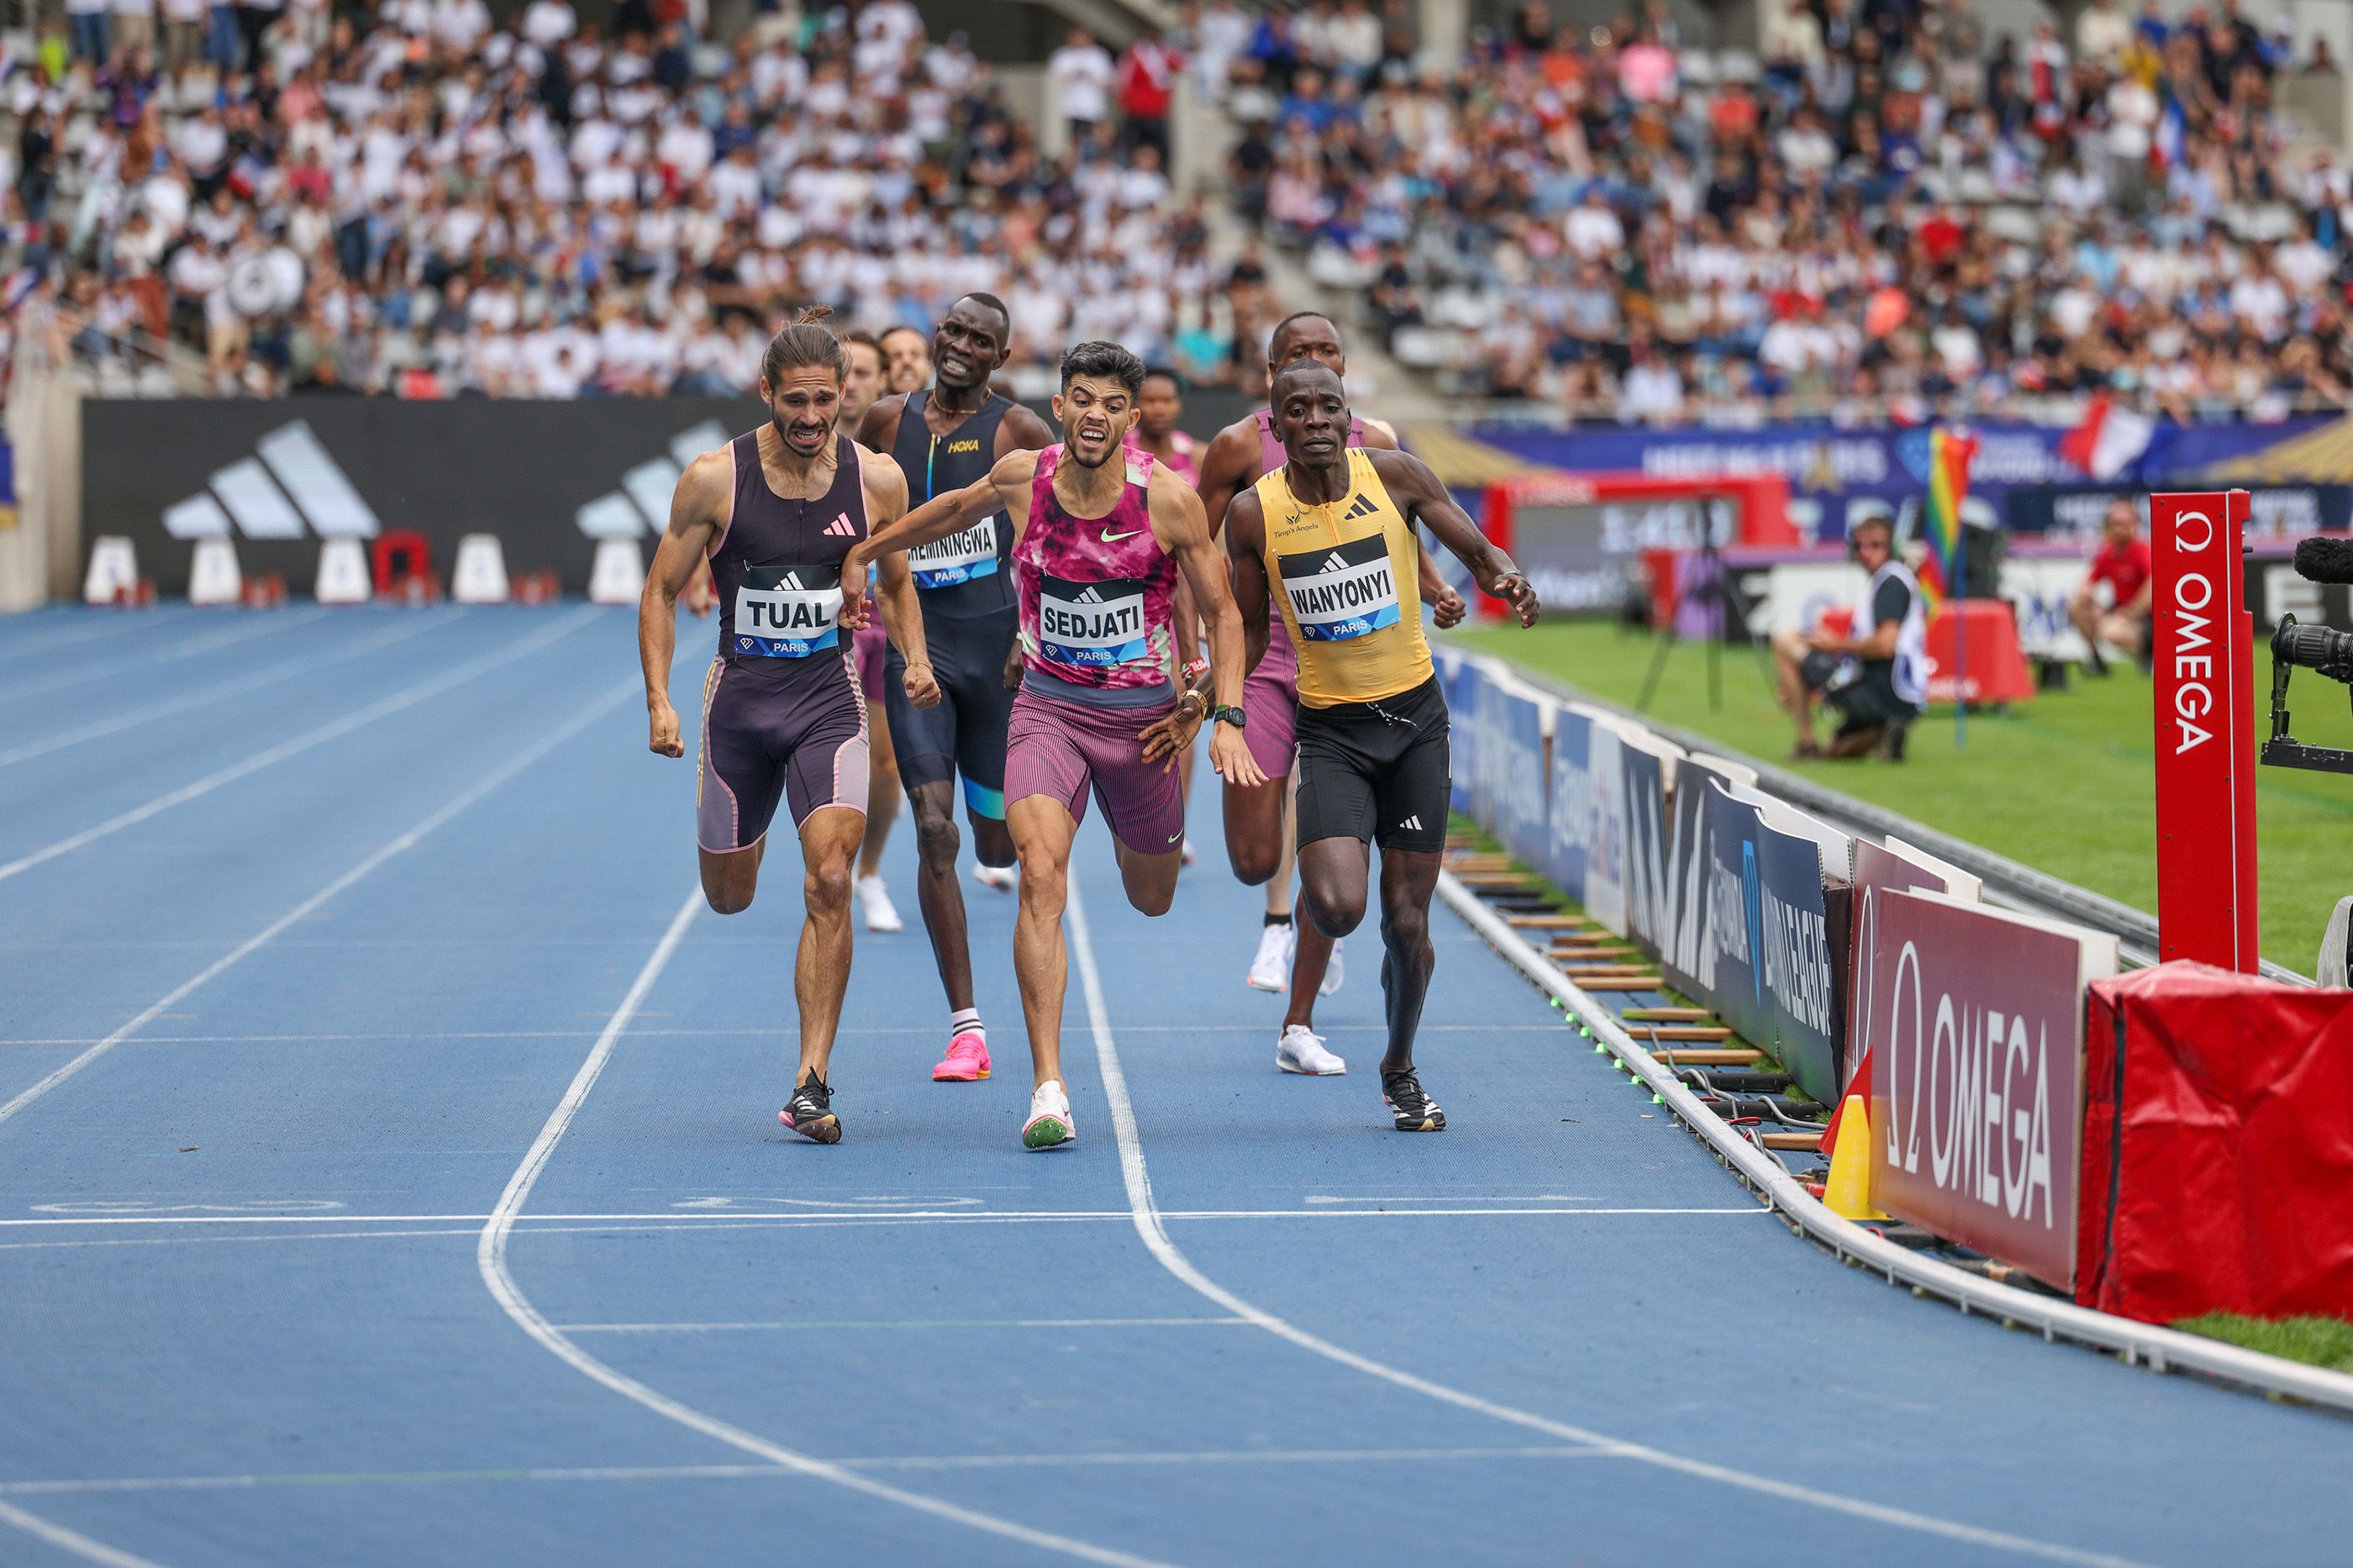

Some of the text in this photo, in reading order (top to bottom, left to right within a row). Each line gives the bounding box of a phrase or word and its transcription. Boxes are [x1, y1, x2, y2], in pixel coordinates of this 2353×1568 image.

[947, 439, 980, 455] HOKA
[1274, 524, 1319, 539] Tirop's Angels
[908, 527, 992, 561] HEMININGWA
[934, 569, 966, 582] PARIS
[1290, 569, 1392, 614] WANYONYI
[746, 601, 831, 629] TUAL
[1044, 605, 1140, 639] SEDJATI
[1333, 620, 1368, 635] PARIS
[773, 643, 808, 653] PARIS
[1076, 651, 1112, 661] PARIS
[2175, 572, 2214, 755] OMEGA
[1929, 993, 2053, 1230] OMEGA
